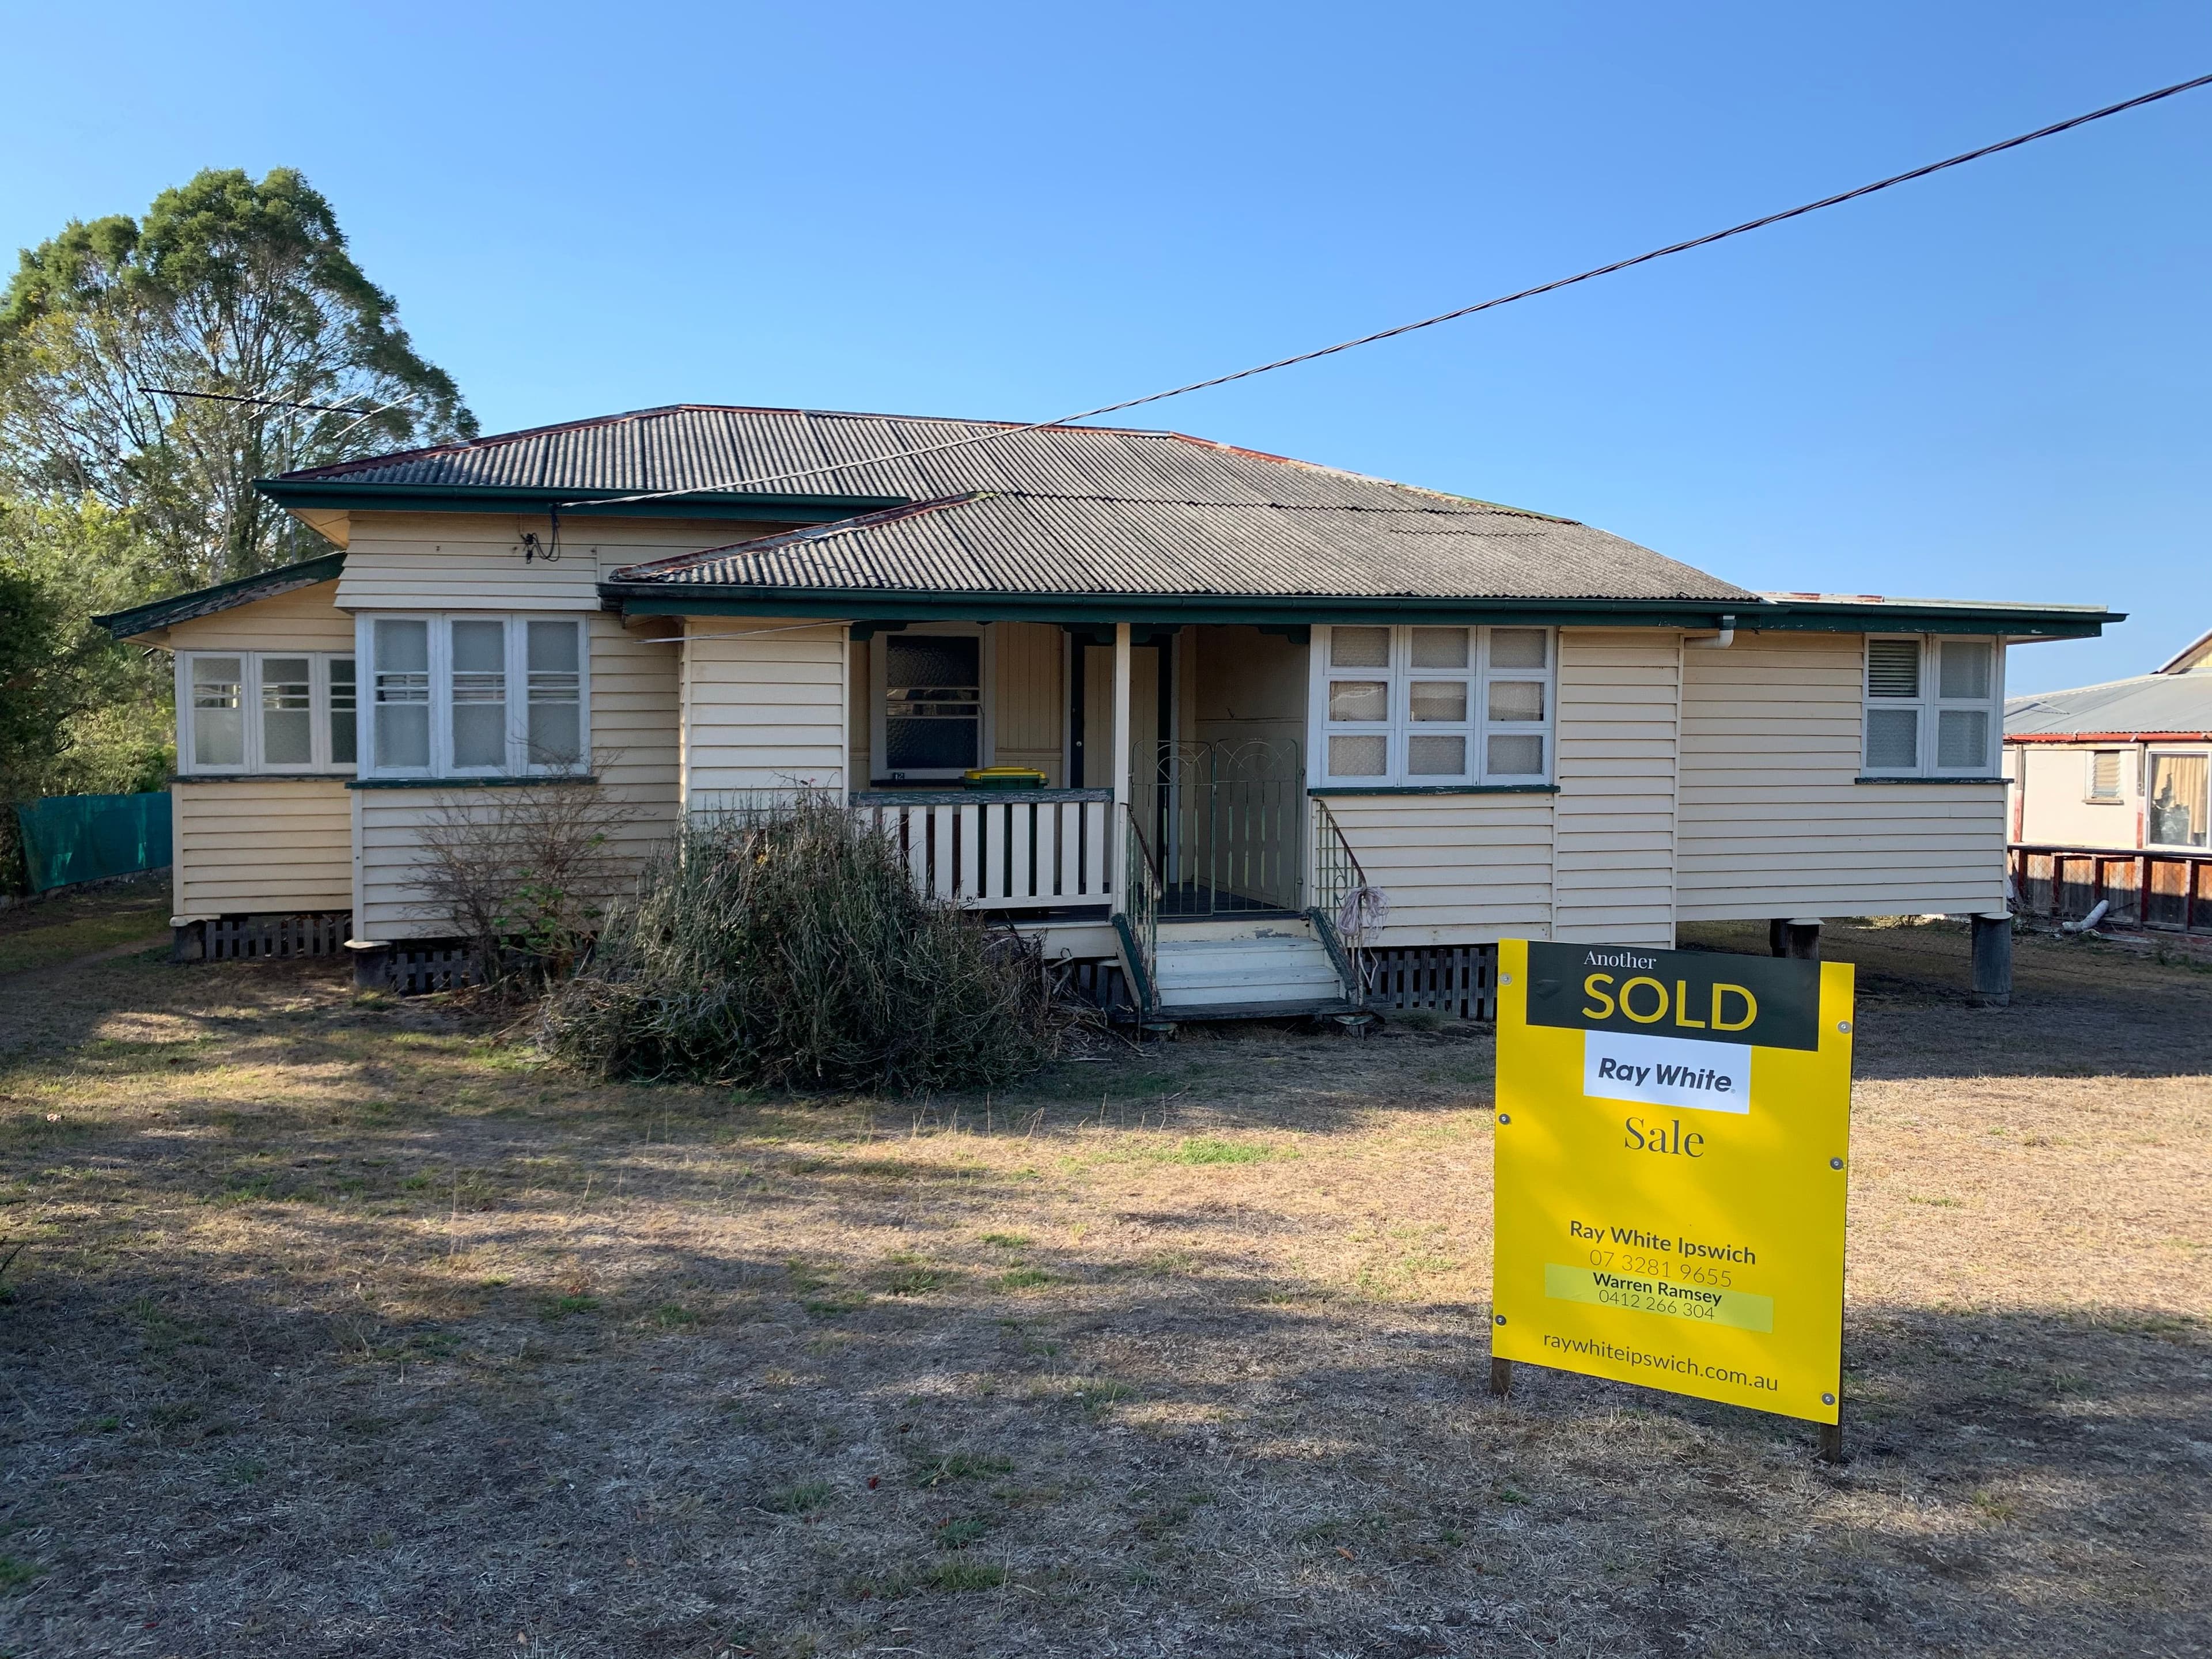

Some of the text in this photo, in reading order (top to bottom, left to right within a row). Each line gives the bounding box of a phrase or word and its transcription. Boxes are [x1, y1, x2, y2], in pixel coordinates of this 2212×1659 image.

[1584, 950, 1657, 969] Another
[1582, 973, 1758, 1031] SOLD
[1598, 1058, 1732, 1092] Ray White
[1624, 1117, 1705, 1158] Sale
[1570, 1220, 1756, 1265] Ray White Ipswich
[1589, 1249, 1732, 1287] 07 3281 9655
[1593, 1272, 1722, 1307] Warren Ramsey
[1599, 1289, 1715, 1320] 0412 266 304
[1543, 1334, 1778, 1392] raywhiteipswich.com.au
